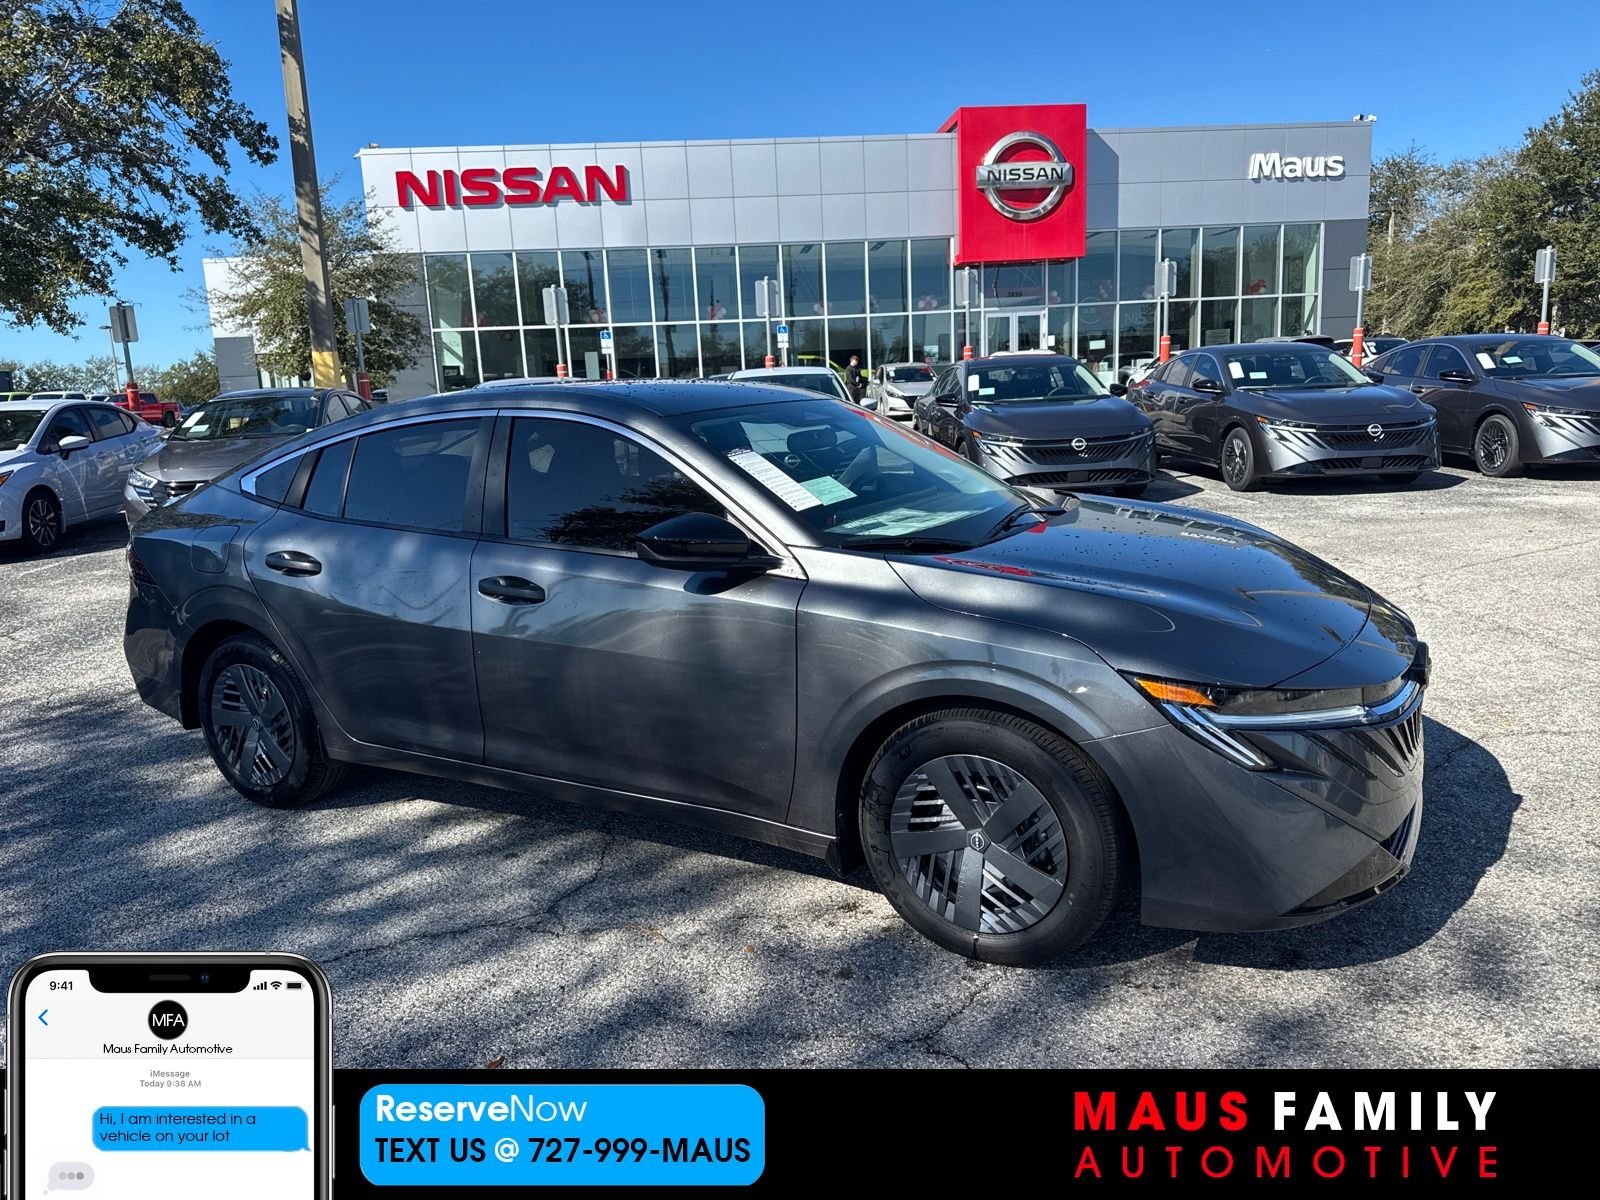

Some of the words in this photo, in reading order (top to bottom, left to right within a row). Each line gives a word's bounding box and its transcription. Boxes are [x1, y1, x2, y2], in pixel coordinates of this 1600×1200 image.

[986, 167, 1064, 182] NISSAN
[1248, 152, 1344, 180] Maus
[395, 165, 629, 208] NISSAN
